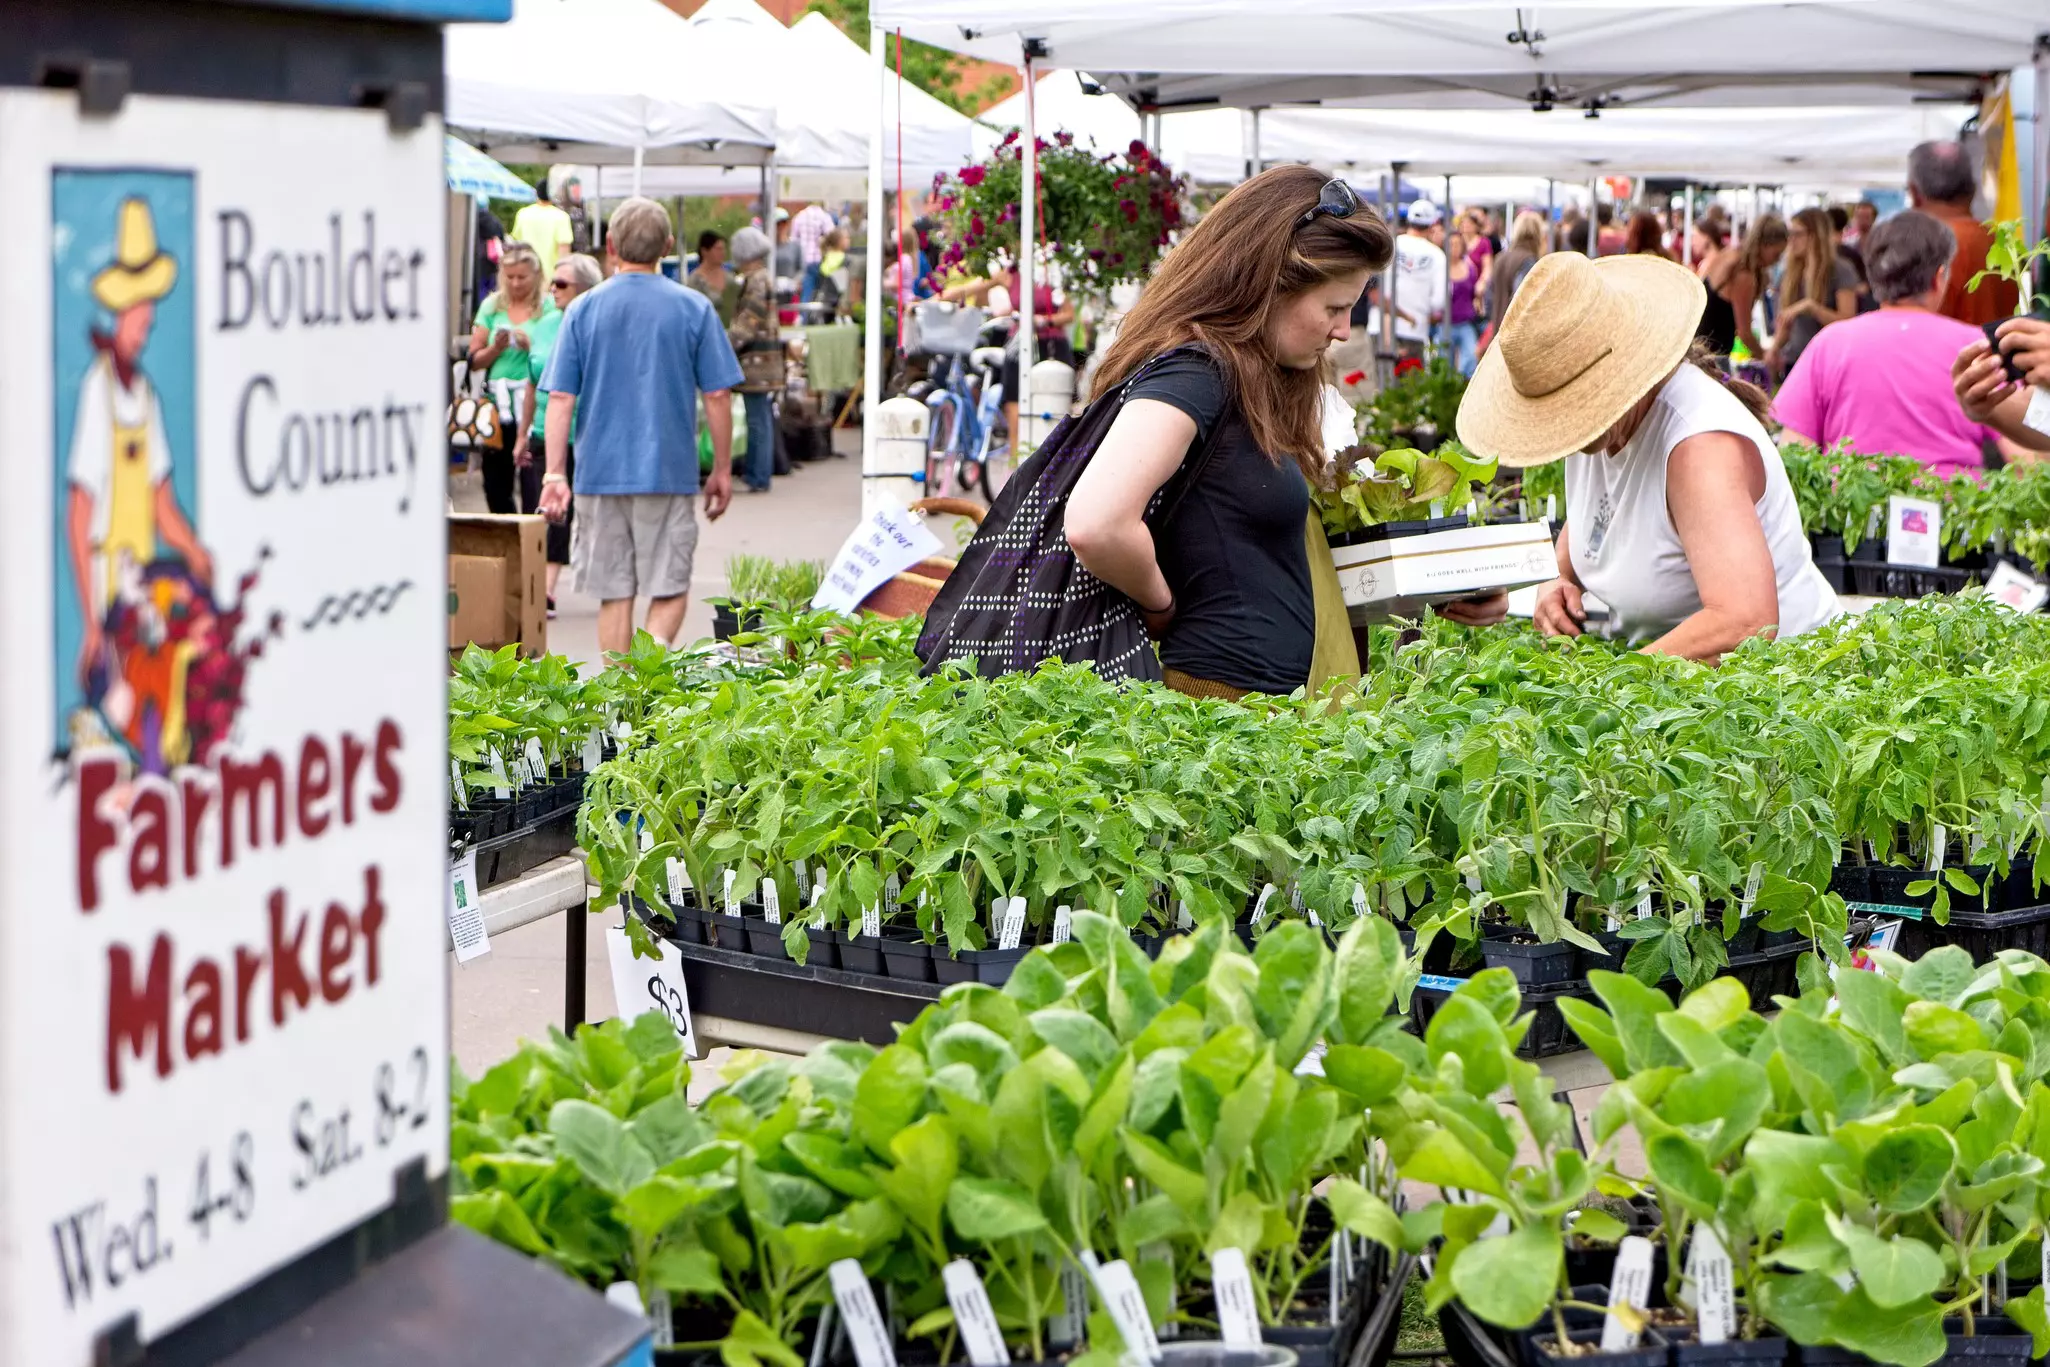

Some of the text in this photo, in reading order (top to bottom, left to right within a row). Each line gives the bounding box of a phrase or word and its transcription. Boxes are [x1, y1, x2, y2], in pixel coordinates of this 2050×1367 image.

[217, 207, 425, 333] Boulder
[238, 375, 425, 514] County
[74, 717, 405, 914] Farmers
[105, 864, 387, 1095] Market
[647, 972, 688, 1037] $3
[51, 1047, 430, 1311] Wed. 4-8 Sat. 8-2
